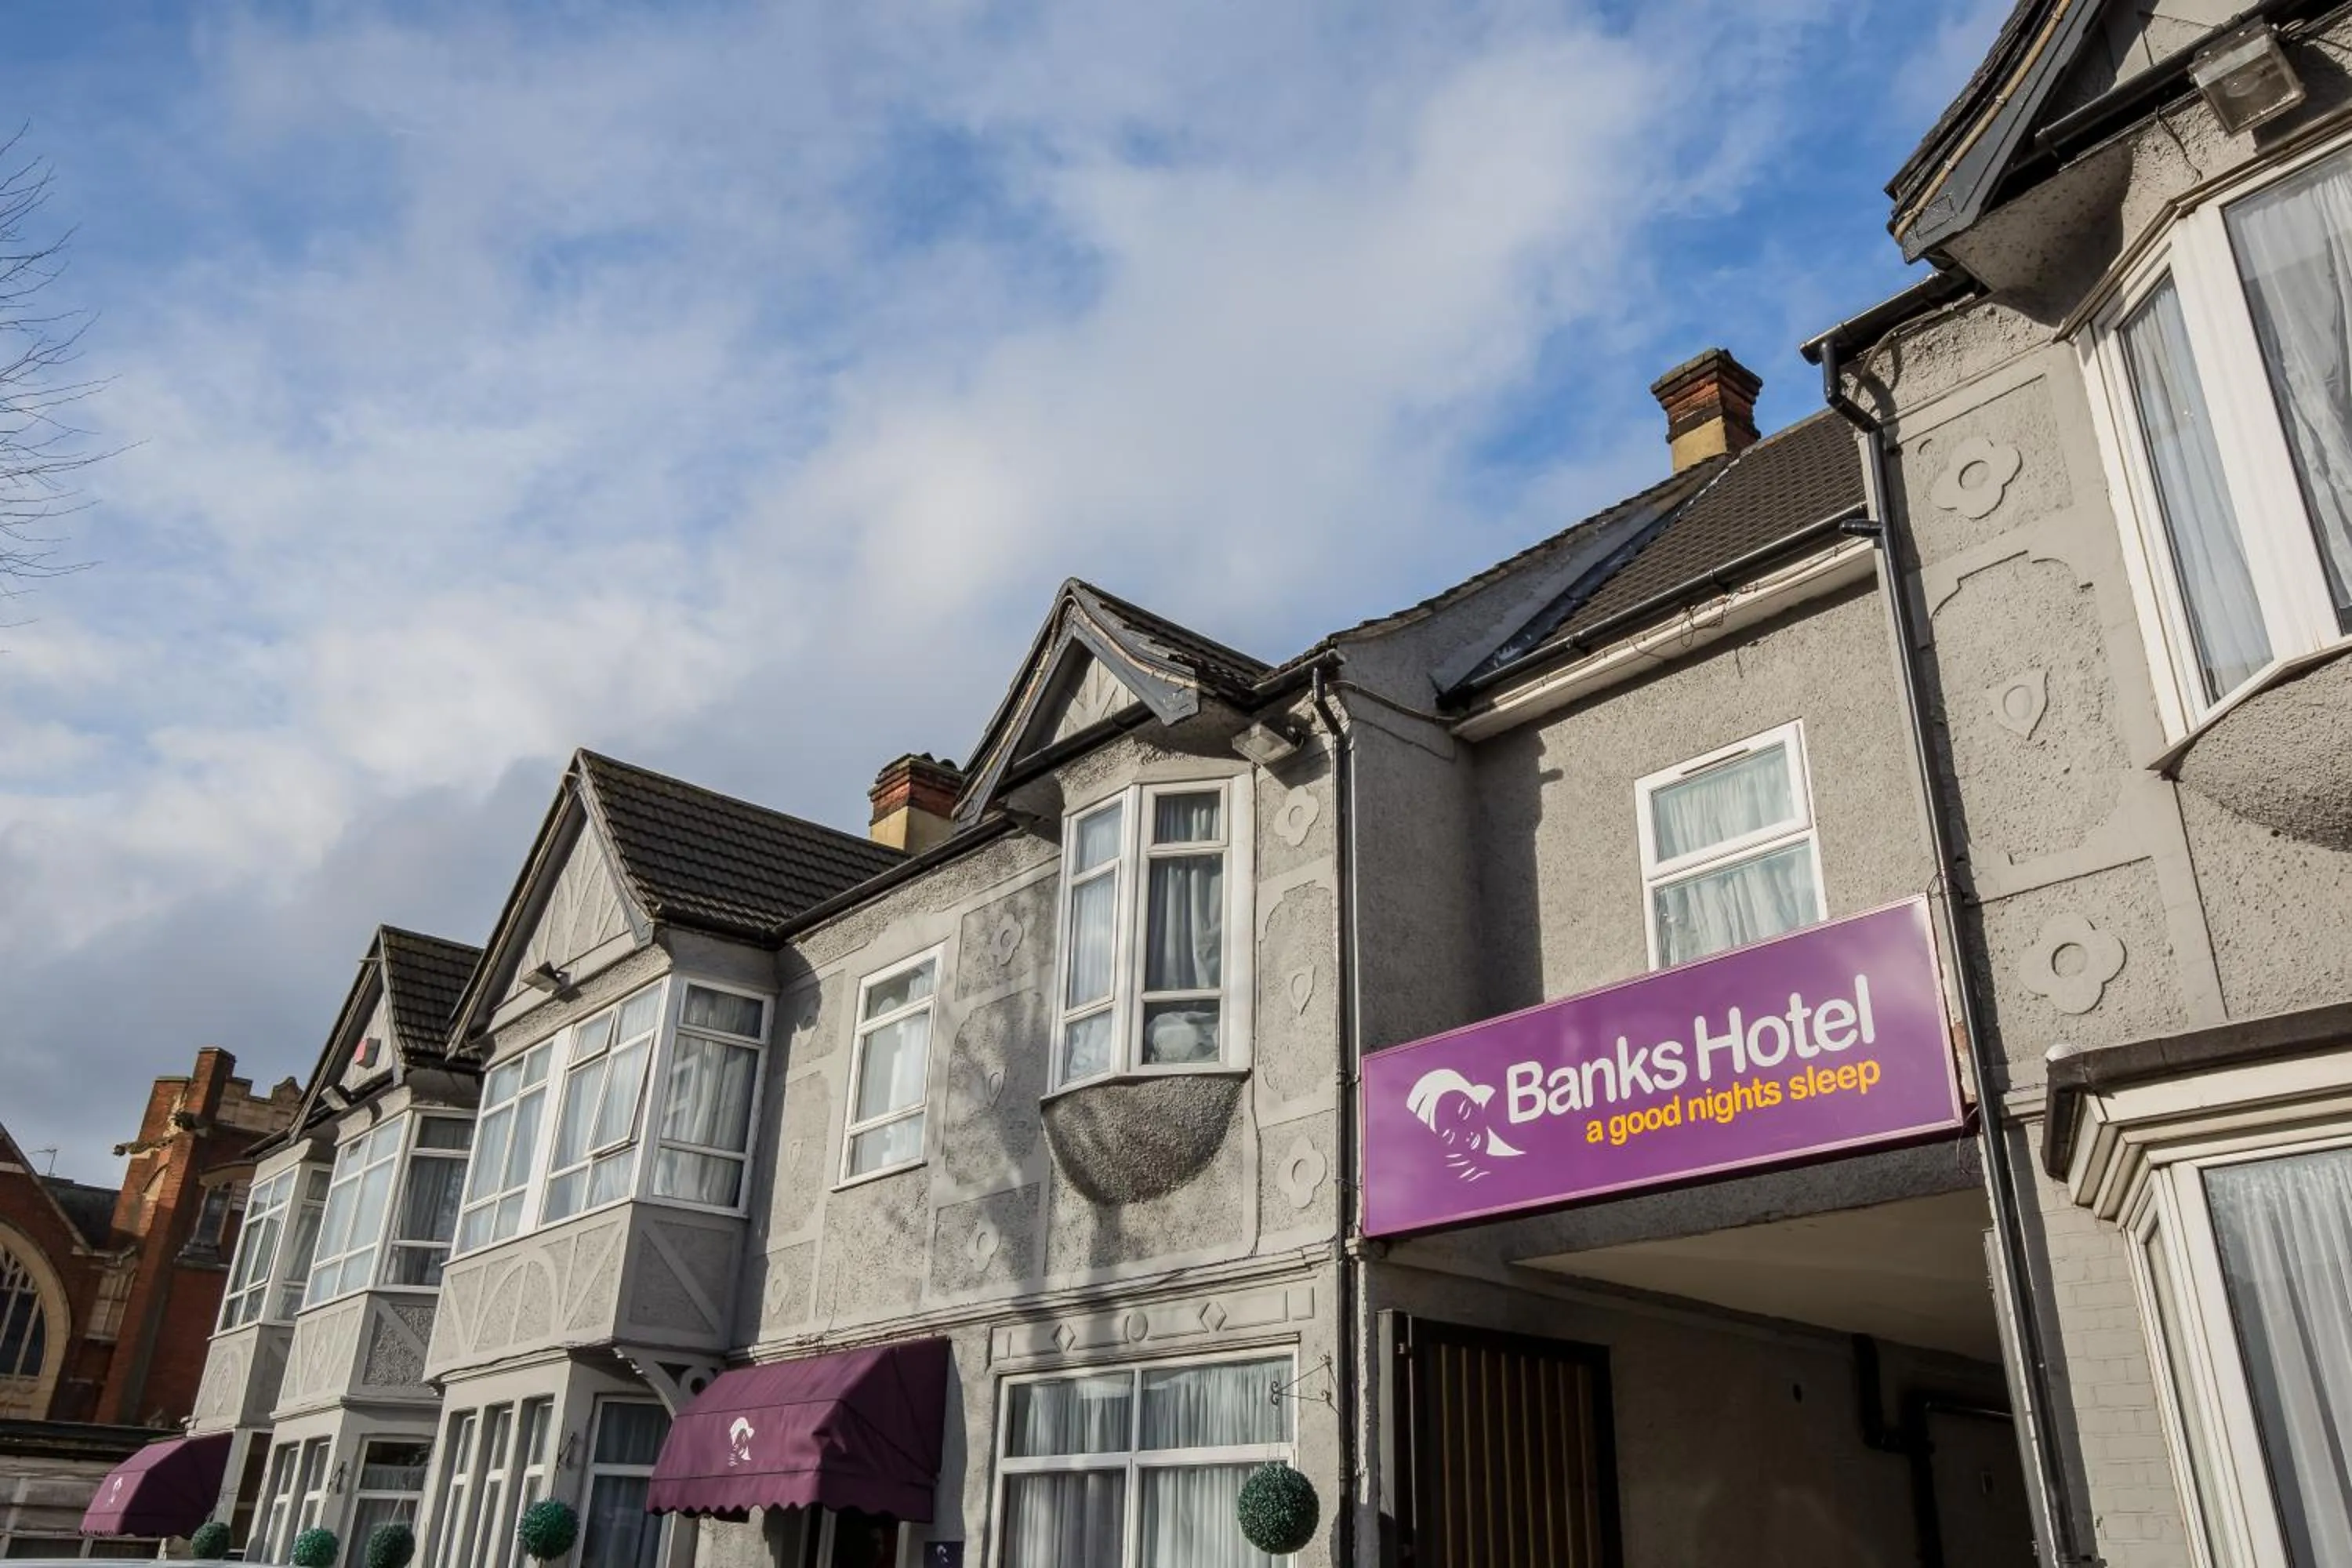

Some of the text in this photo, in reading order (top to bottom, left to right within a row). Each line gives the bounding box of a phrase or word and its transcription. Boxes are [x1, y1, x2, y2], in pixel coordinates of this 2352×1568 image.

[1506, 973, 1876, 1123] Banks Hotel
[1584, 1059, 1881, 1146] a good nights sleep
